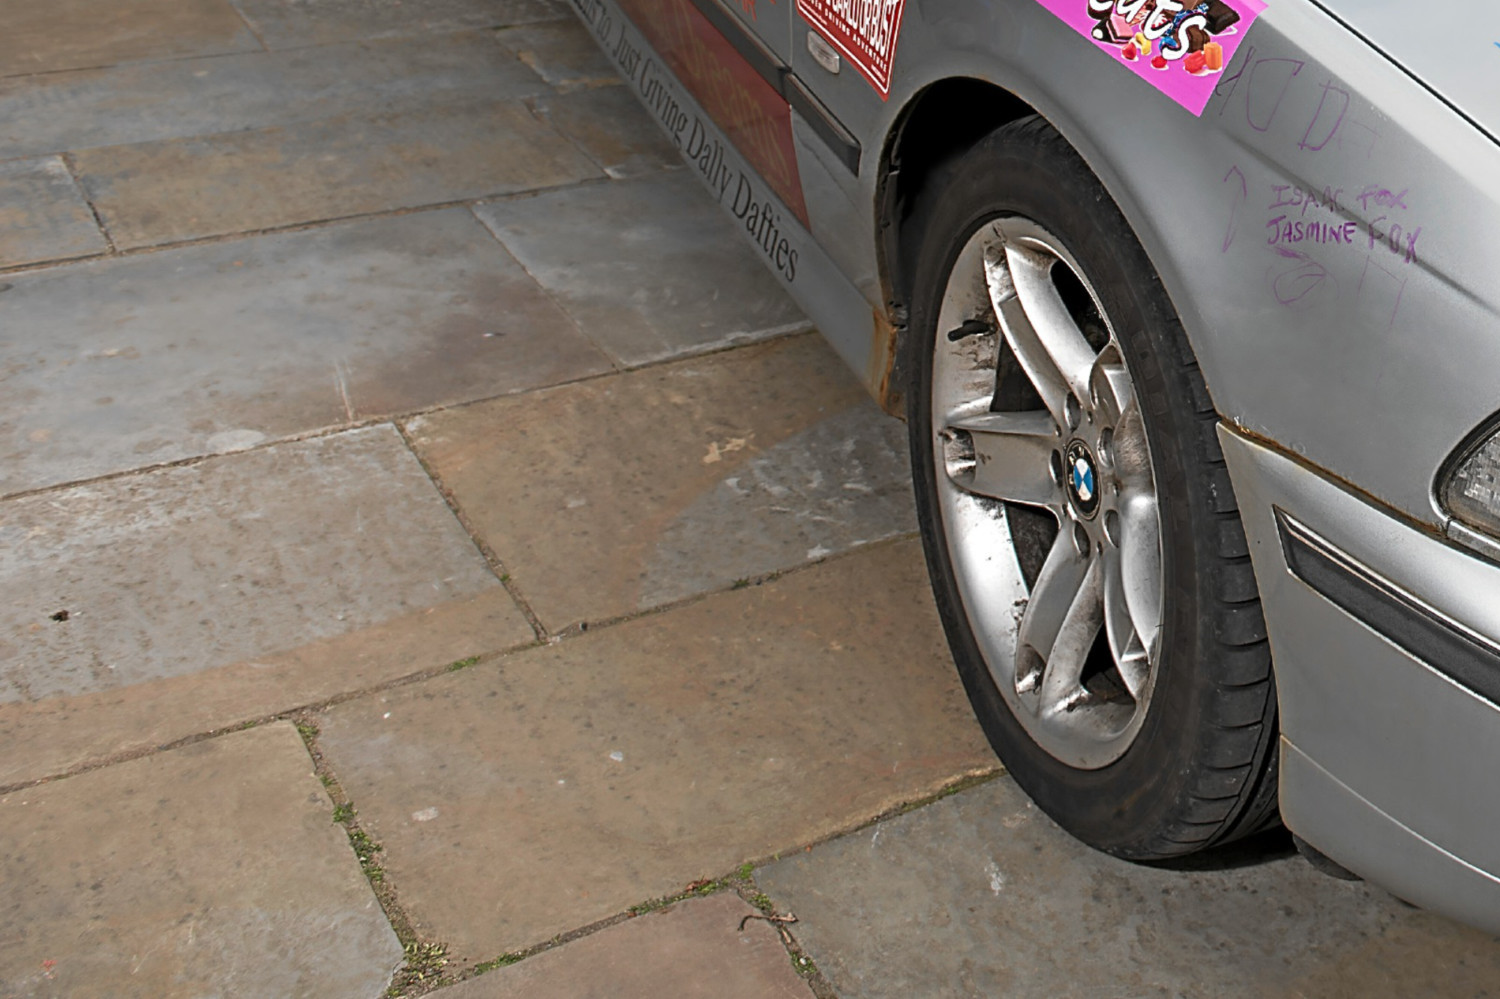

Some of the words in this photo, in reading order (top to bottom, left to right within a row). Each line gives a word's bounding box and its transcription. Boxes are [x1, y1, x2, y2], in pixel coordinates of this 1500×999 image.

[613, 22, 643, 83] Just
[640, 56, 690, 146] Giving
[686, 115, 734, 199] Dally
[731, 170, 799, 284] Dafties
[1266, 214, 1358, 245] JASMINE
[1368, 215, 1422, 265] FOX
